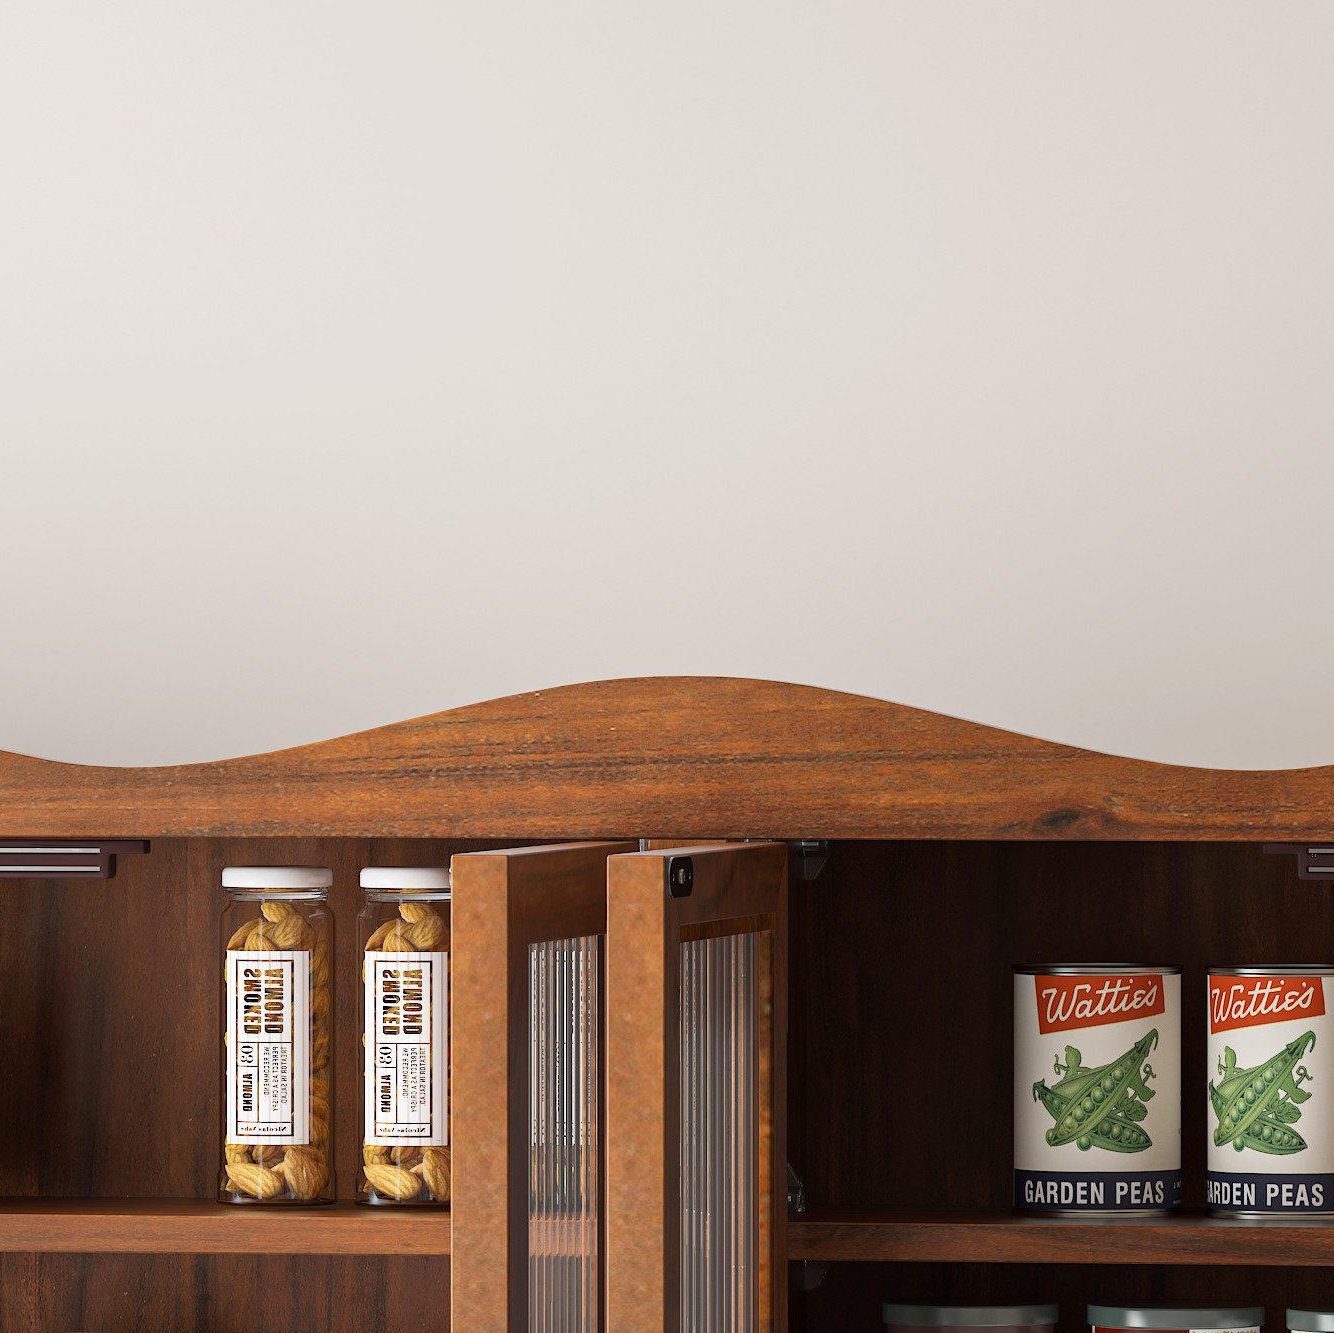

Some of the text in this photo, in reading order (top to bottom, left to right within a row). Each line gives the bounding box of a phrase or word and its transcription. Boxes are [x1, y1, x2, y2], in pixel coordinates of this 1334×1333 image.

[1042, 978, 1158, 1024] Wattie's
[1211, 979, 1315, 1024] Wattie's
[1024, 1178, 1165, 1205] GARDEN PEAS
[1207, 1180, 1324, 1207] ARDEN PEAS
